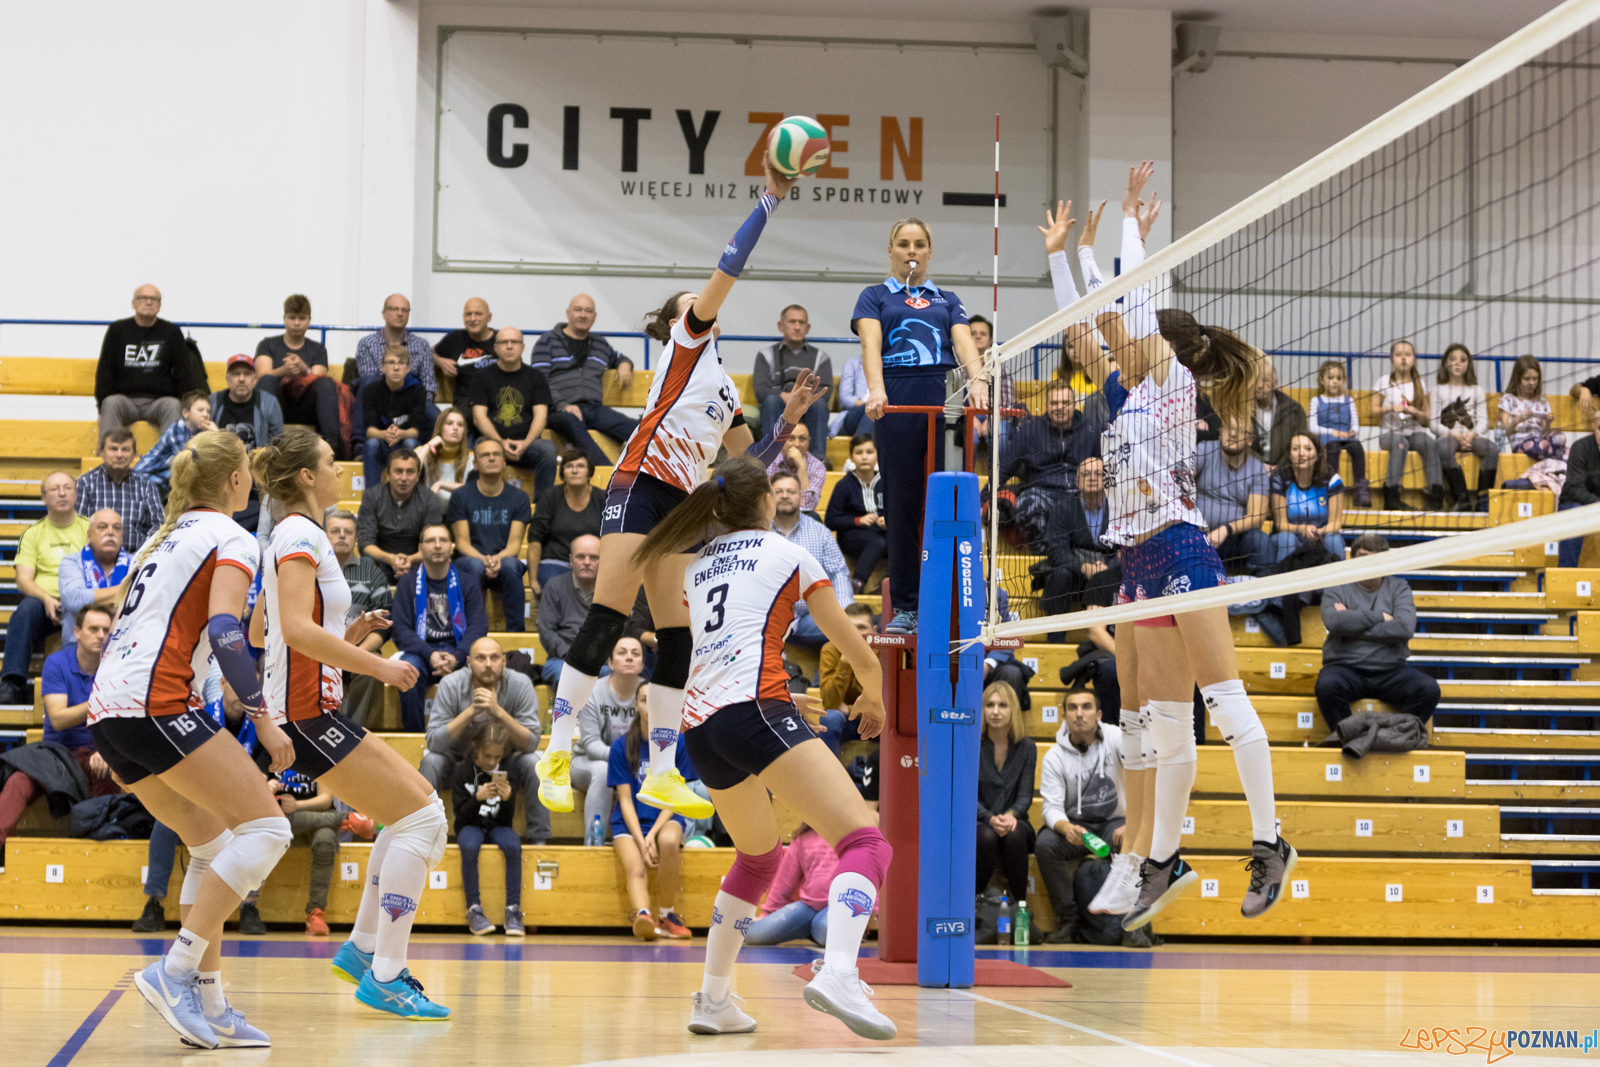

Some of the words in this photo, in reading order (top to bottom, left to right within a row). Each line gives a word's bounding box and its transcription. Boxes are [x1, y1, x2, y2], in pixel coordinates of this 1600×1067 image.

[486, 102, 924, 182] CITYZEN
[620, 180, 693, 200] WIĘCEJ
[705, 182, 737, 199] NIŻ
[750, 187, 801, 201] KB
[812, 187, 924, 205] SPORTOWY
[124, 344, 160, 362] EA7
[605, 504, 622, 520] 99
[700, 538, 765, 559] JURCZYK
[711, 554, 738, 567] ENEA
[694, 559, 759, 588] ENERGETYK
[960, 556, 973, 607] Senoh
[704, 582, 730, 634] 3
[873, 636, 906, 645] Senoh
[1046, 709, 1055, 717] 13
[781, 716, 799, 732] 3
[1301, 715, 1310, 723] 10
[168, 713, 198, 737] 16
[318, 726, 346, 748] 19
[1329, 767, 1339, 776] 10
[1419, 768, 1424, 776] 9
[1359, 822, 1369, 831] 10
[1452, 823, 1458, 832] 9
[52, 867, 58, 877] 8
[346, 865, 353, 875] 5
[435, 874, 441, 883] 4
[1205, 882, 1215, 891] 12
[1296, 883, 1305, 892] 11
[1389, 887, 1399, 896] 10
[1482, 889, 1488, 897] 9
